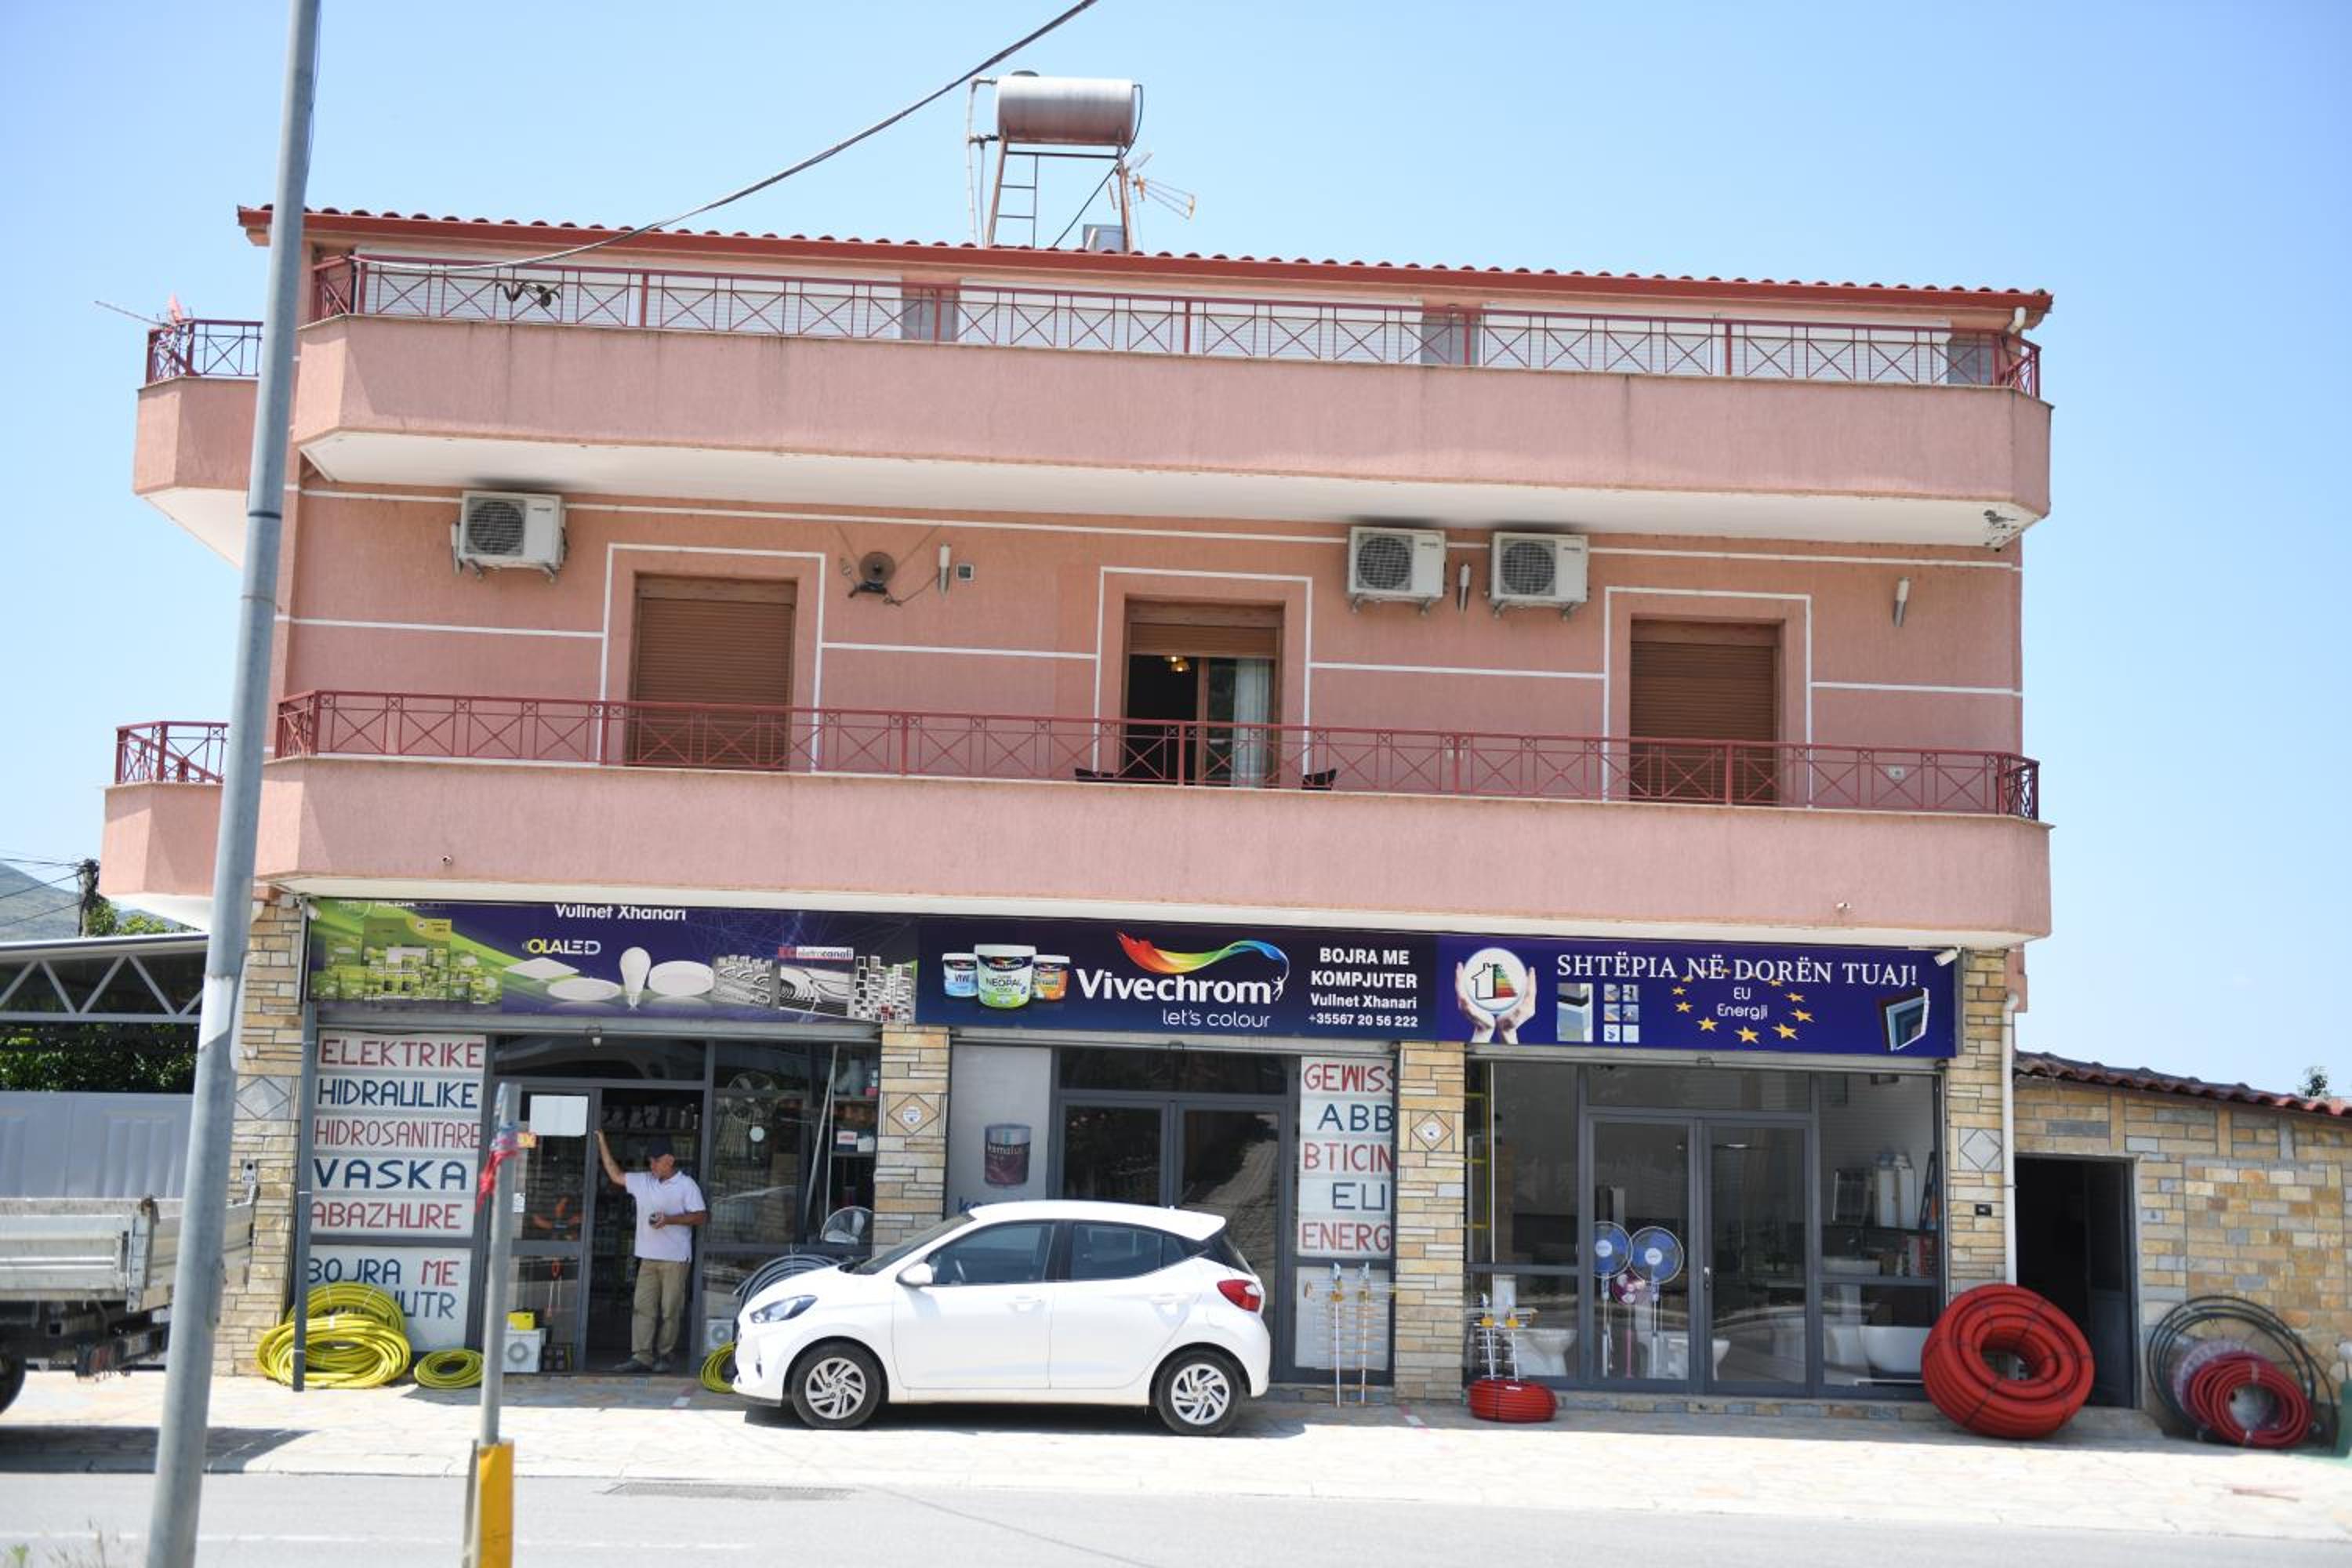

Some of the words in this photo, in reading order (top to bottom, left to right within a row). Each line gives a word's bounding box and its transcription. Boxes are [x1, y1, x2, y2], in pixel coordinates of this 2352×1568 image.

[555, 904, 613, 919] Vullnet
[618, 906, 686, 920] Xhanari
[1319, 947, 1378, 964] BOJRA
[1383, 949, 1410, 965] ME
[1557, 951, 1678, 978] SHTËPIA
[1686, 954, 1725, 979] NË
[1733, 956, 1832, 983] DORËN
[1842, 963, 1917, 988] TUAJ!
[1076, 968, 1271, 1004] Vivechrom
[1311, 971, 1417, 989] KOMPJUTER
[1733, 987, 1751, 1000] EU
[1310, 993, 1359, 1007] Vullnet
[1363, 995, 1417, 1009] Xhanari
[1717, 1003, 1768, 1020] Energji
[1163, 1008, 1201, 1027] let's
[1207, 1011, 1271, 1028] colour
[1308, 1012, 1354, 1025] +35567
[1358, 1014, 1373, 1026] 20
[1376, 1015, 1392, 1026] 56
[1395, 1016, 1418, 1028] 222
[321, 1039, 484, 1069] ELEKTRIKE
[318, 1078, 479, 1109] HIDRAULIKE
[1317, 1103, 1393, 1133] ABB
[314, 1119, 481, 1149] HIDROSANITARE
[314, 1158, 467, 1190] VASKA
[310, 1201, 463, 1230] ABAZHURE
[1302, 1222, 1390, 1251] ENERG
[308, 1258, 401, 1285] BOJRA
[421, 1260, 460, 1287] ME
